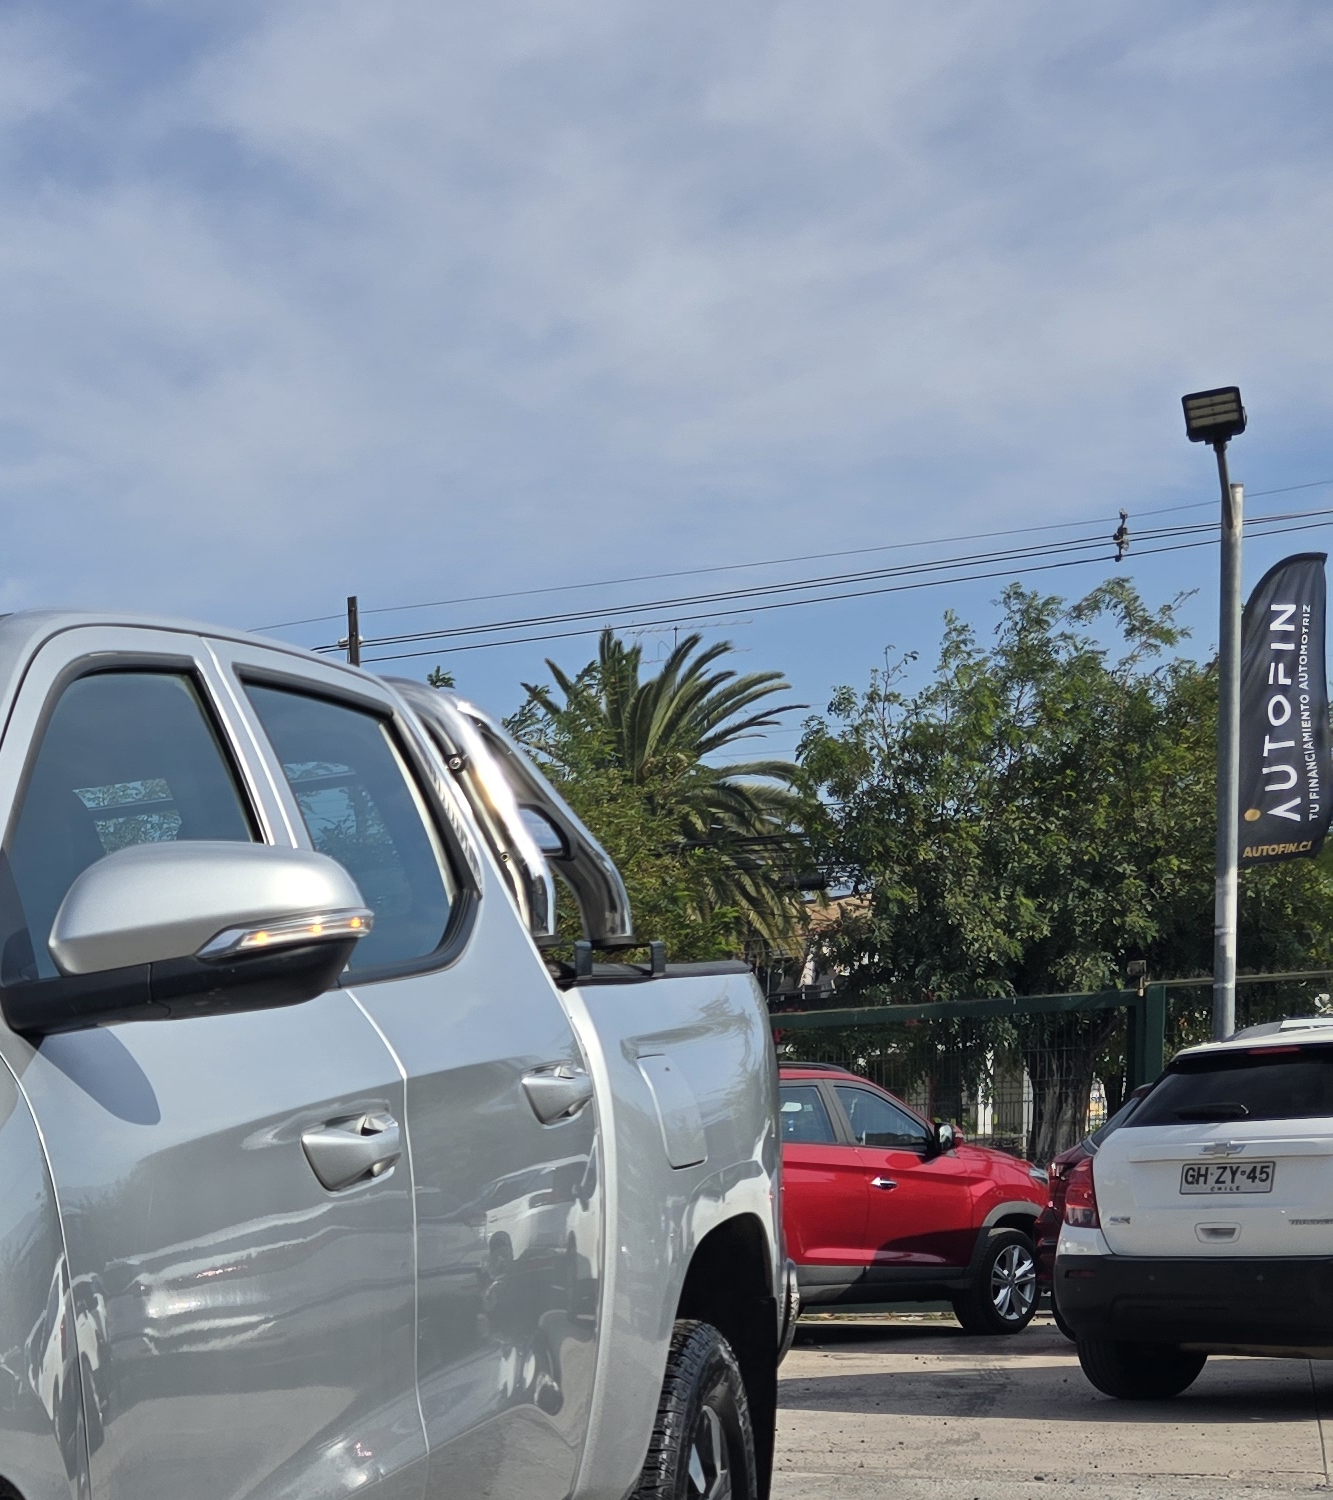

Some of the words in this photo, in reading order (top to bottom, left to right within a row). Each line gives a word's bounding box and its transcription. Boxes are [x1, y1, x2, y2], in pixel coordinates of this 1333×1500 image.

[1297, 604, 1311, 690] AUTOMOTRIZ
[1262, 603, 1301, 821] AUTOFIN
[1299, 694, 1320, 799] FINANCIAMIENTO
[1308, 803, 1320, 821] TU
